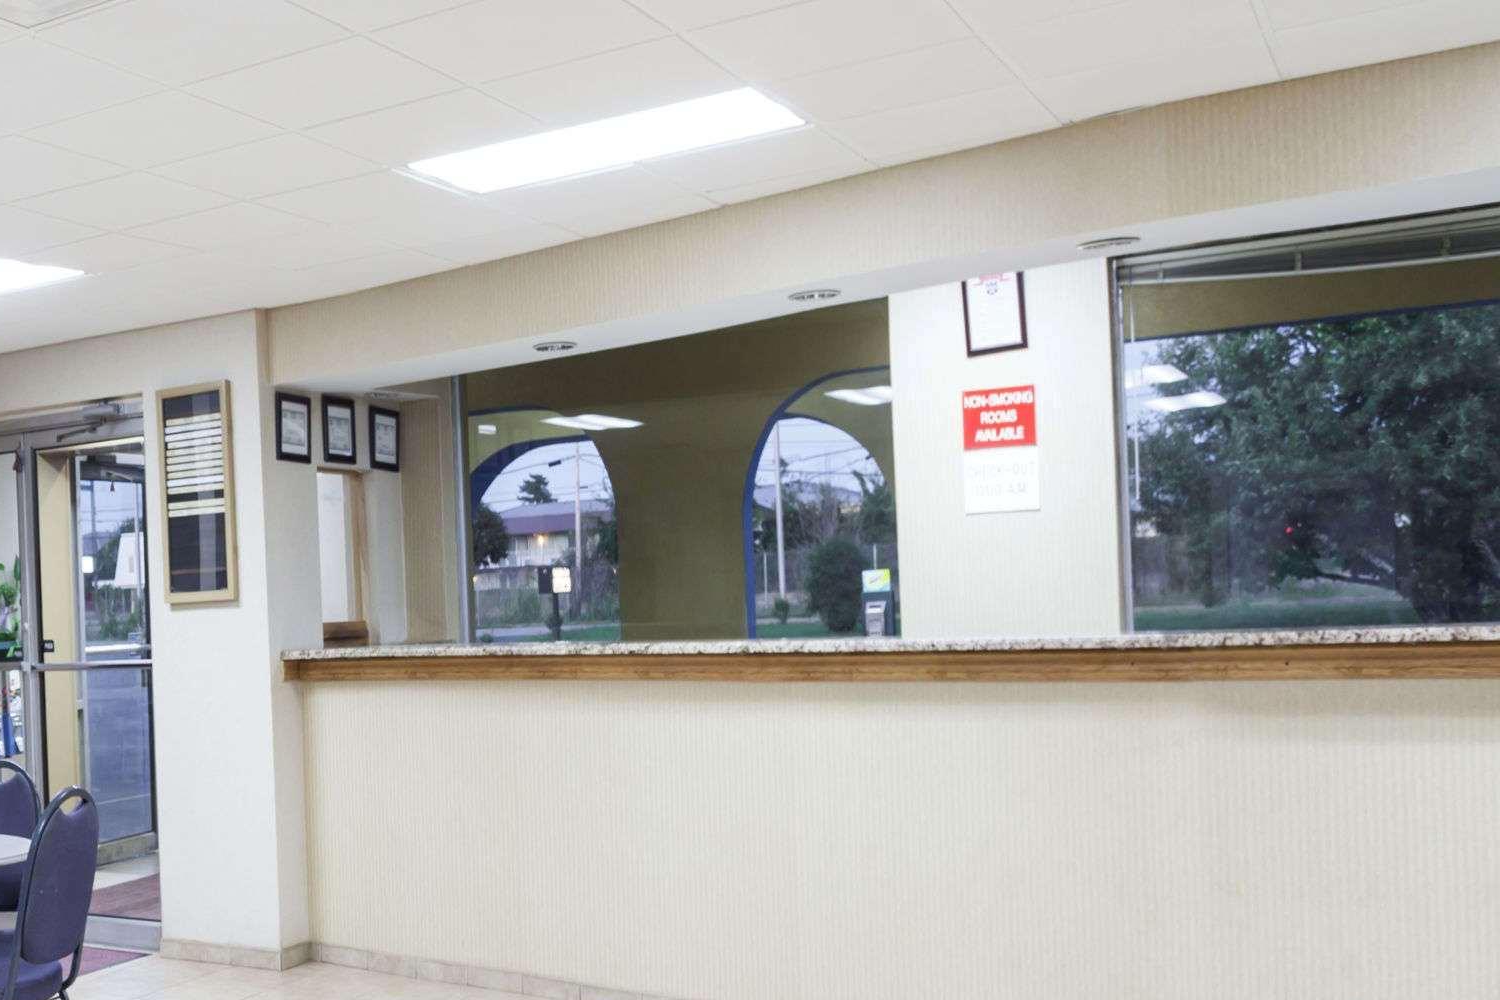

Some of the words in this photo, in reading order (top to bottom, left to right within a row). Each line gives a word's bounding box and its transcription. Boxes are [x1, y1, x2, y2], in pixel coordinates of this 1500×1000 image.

[964, 391, 1034, 408] NON-SMOKING
[980, 409, 1017, 424] ROOMS
[974, 426, 1024, 442] AVAILABLE
